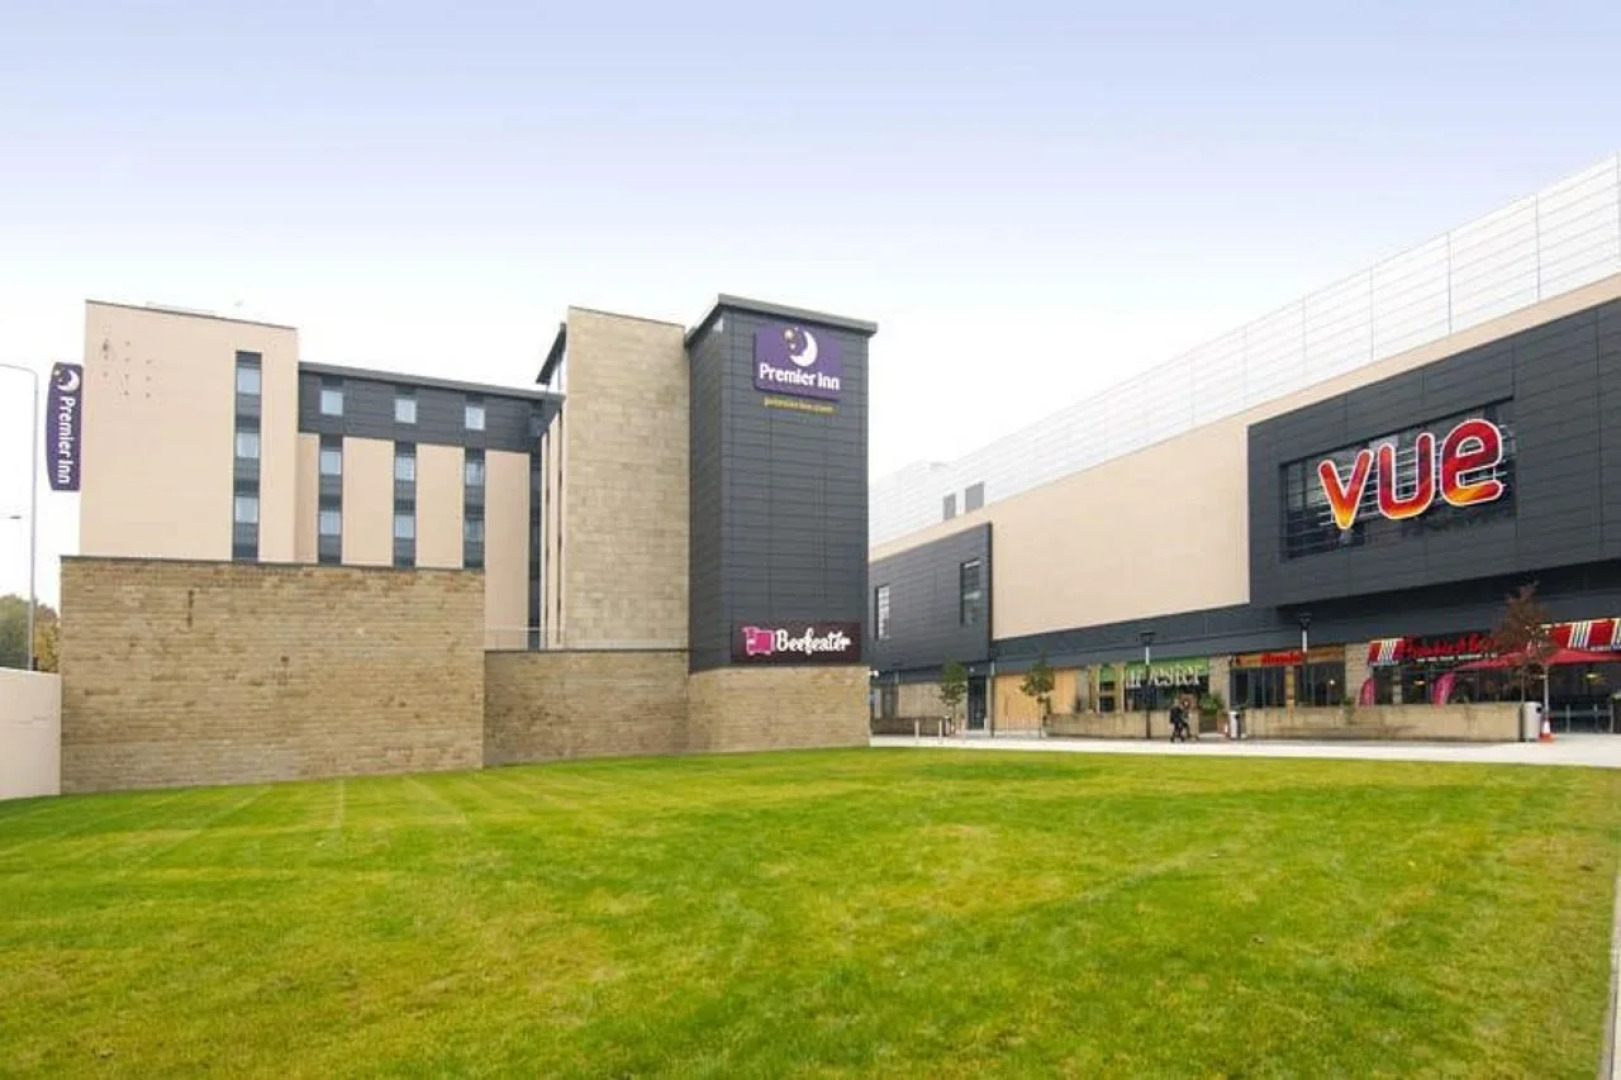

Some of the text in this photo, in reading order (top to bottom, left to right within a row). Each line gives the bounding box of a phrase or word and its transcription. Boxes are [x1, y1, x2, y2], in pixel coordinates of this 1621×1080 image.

[759, 362, 840, 390] Premier Inn
[58, 396, 76, 484] Premier Inn
